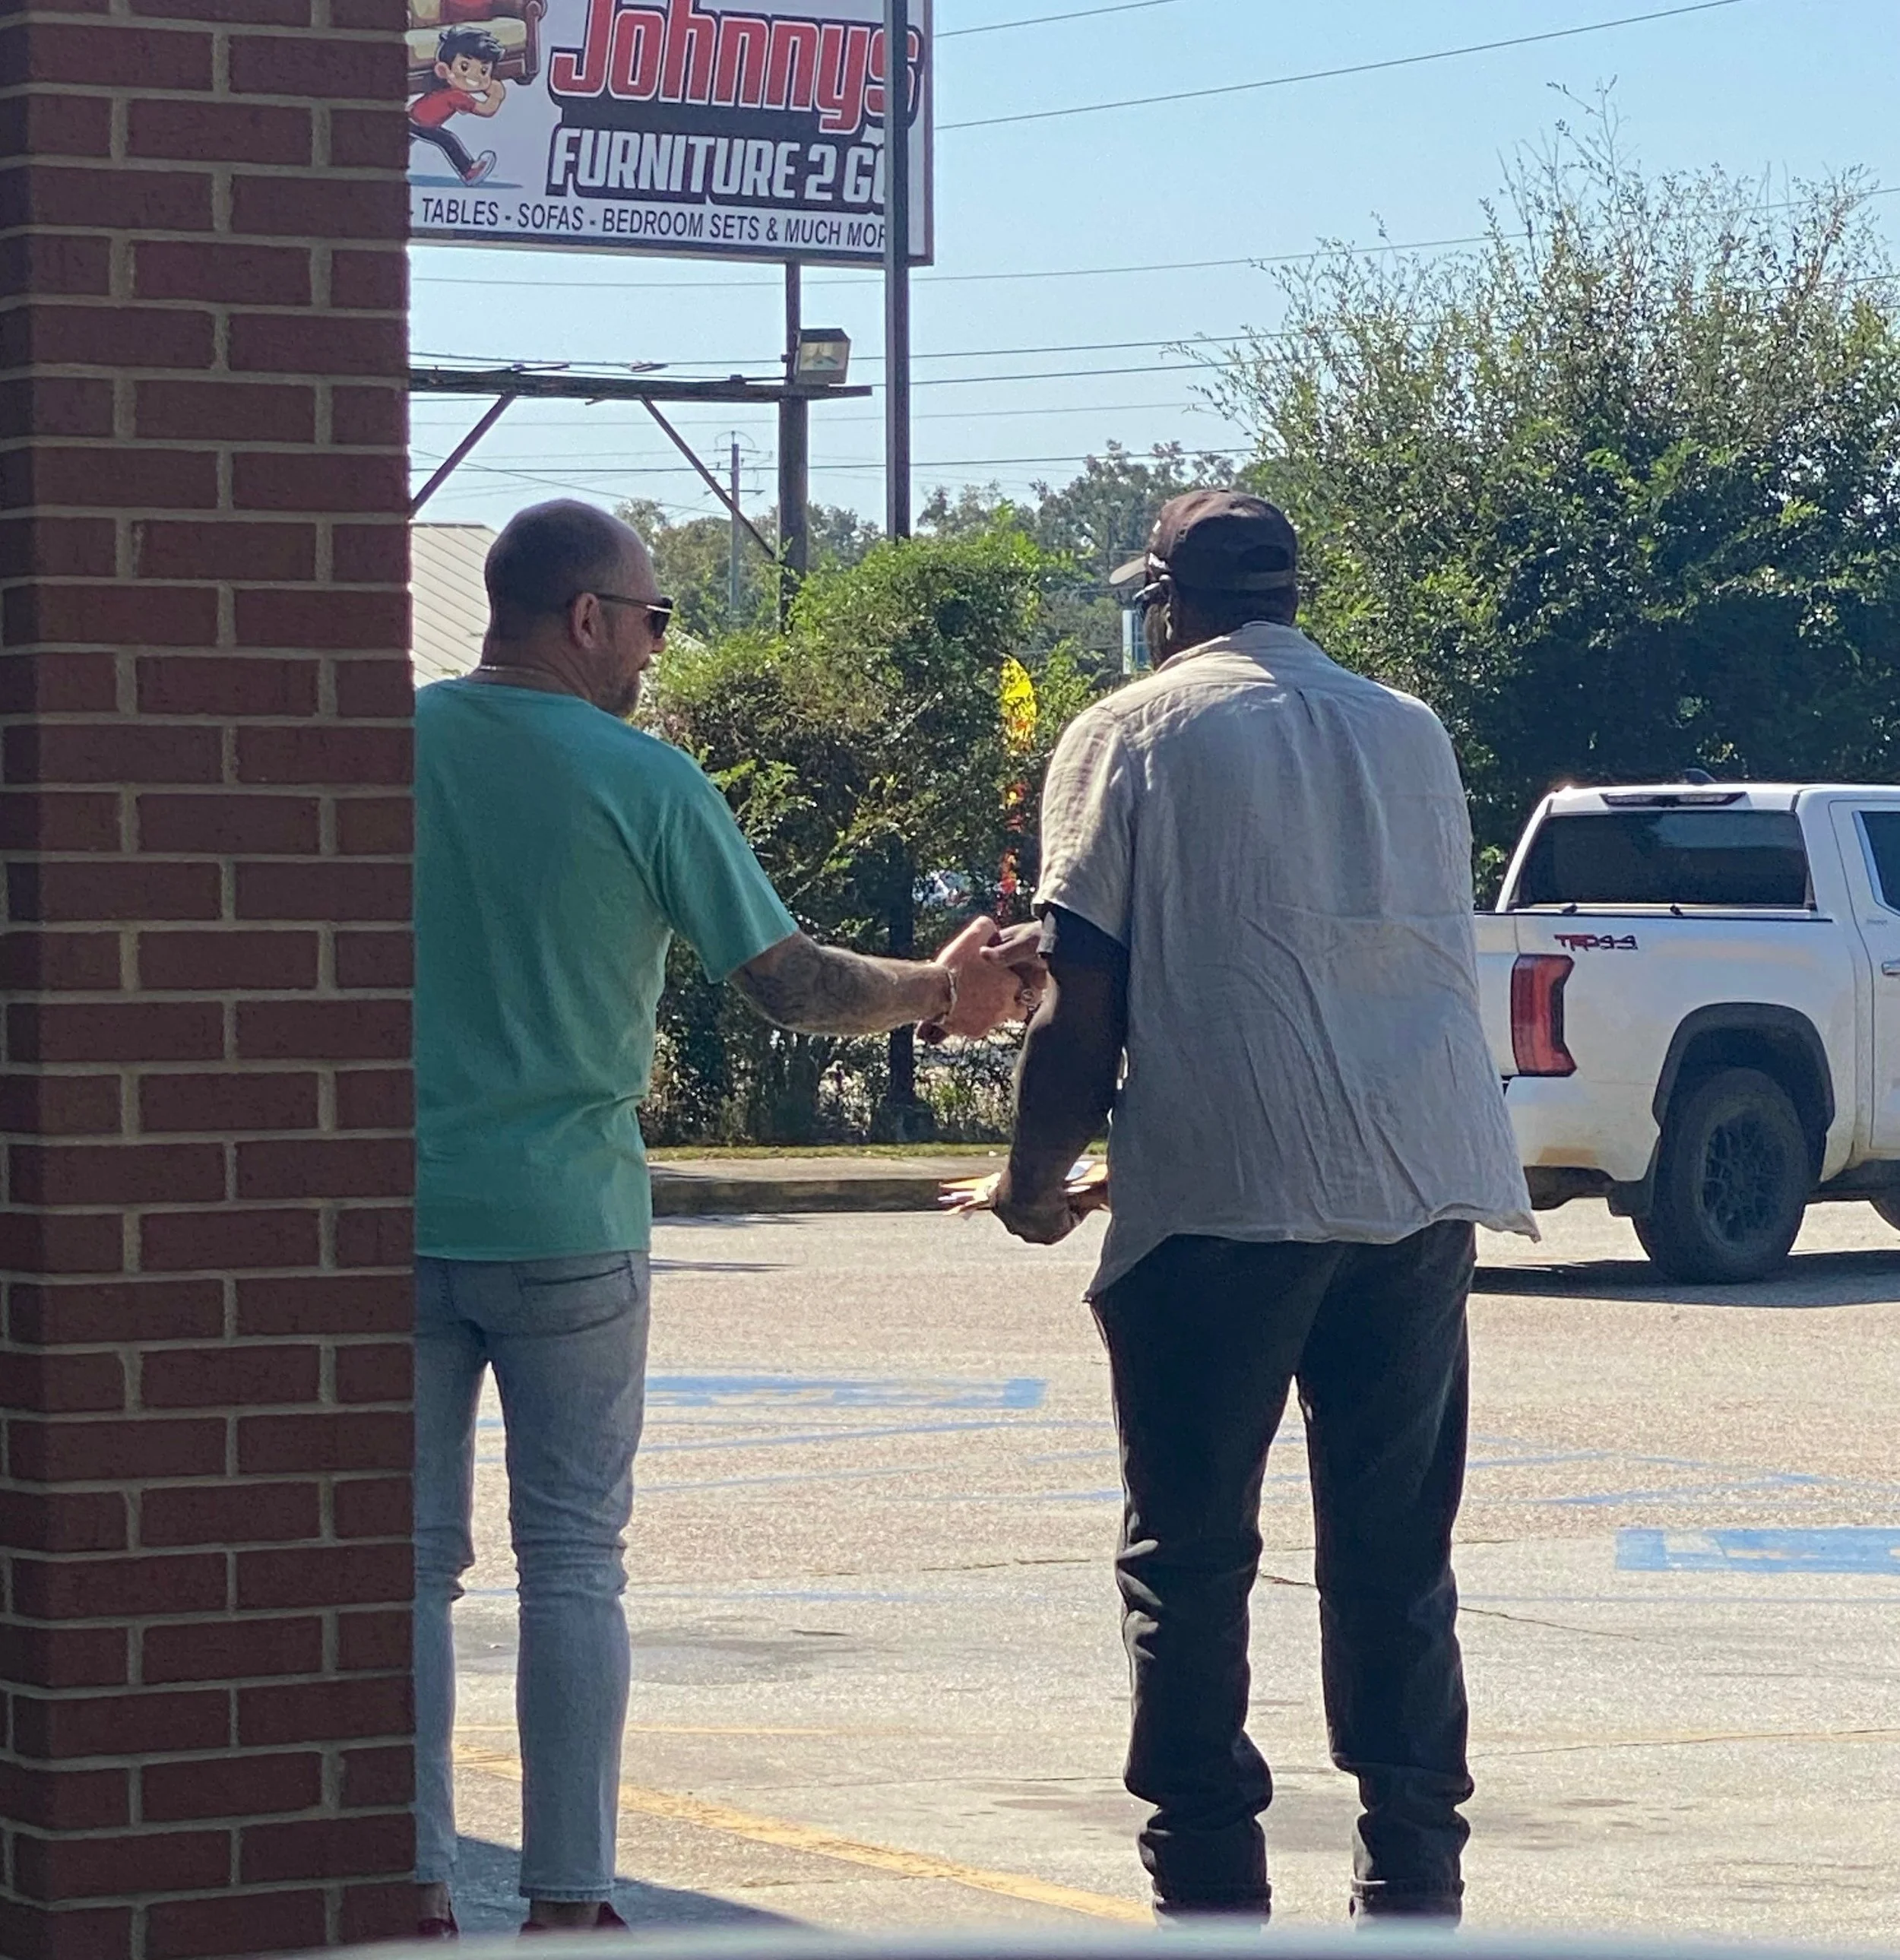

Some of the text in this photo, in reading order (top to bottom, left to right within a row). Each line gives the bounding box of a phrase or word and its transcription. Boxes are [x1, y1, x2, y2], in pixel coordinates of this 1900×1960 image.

[550, 127, 801, 199] FURNITURE
[804, 143, 838, 201] 2
[422, 197, 499, 226] TABLES
[517, 202, 584, 231] SOFAS
[601, 207, 704, 239] BEDROOM
[709, 213, 760, 241] SETS
[766, 217, 779, 242] &
[784, 218, 841, 246] MUCH
